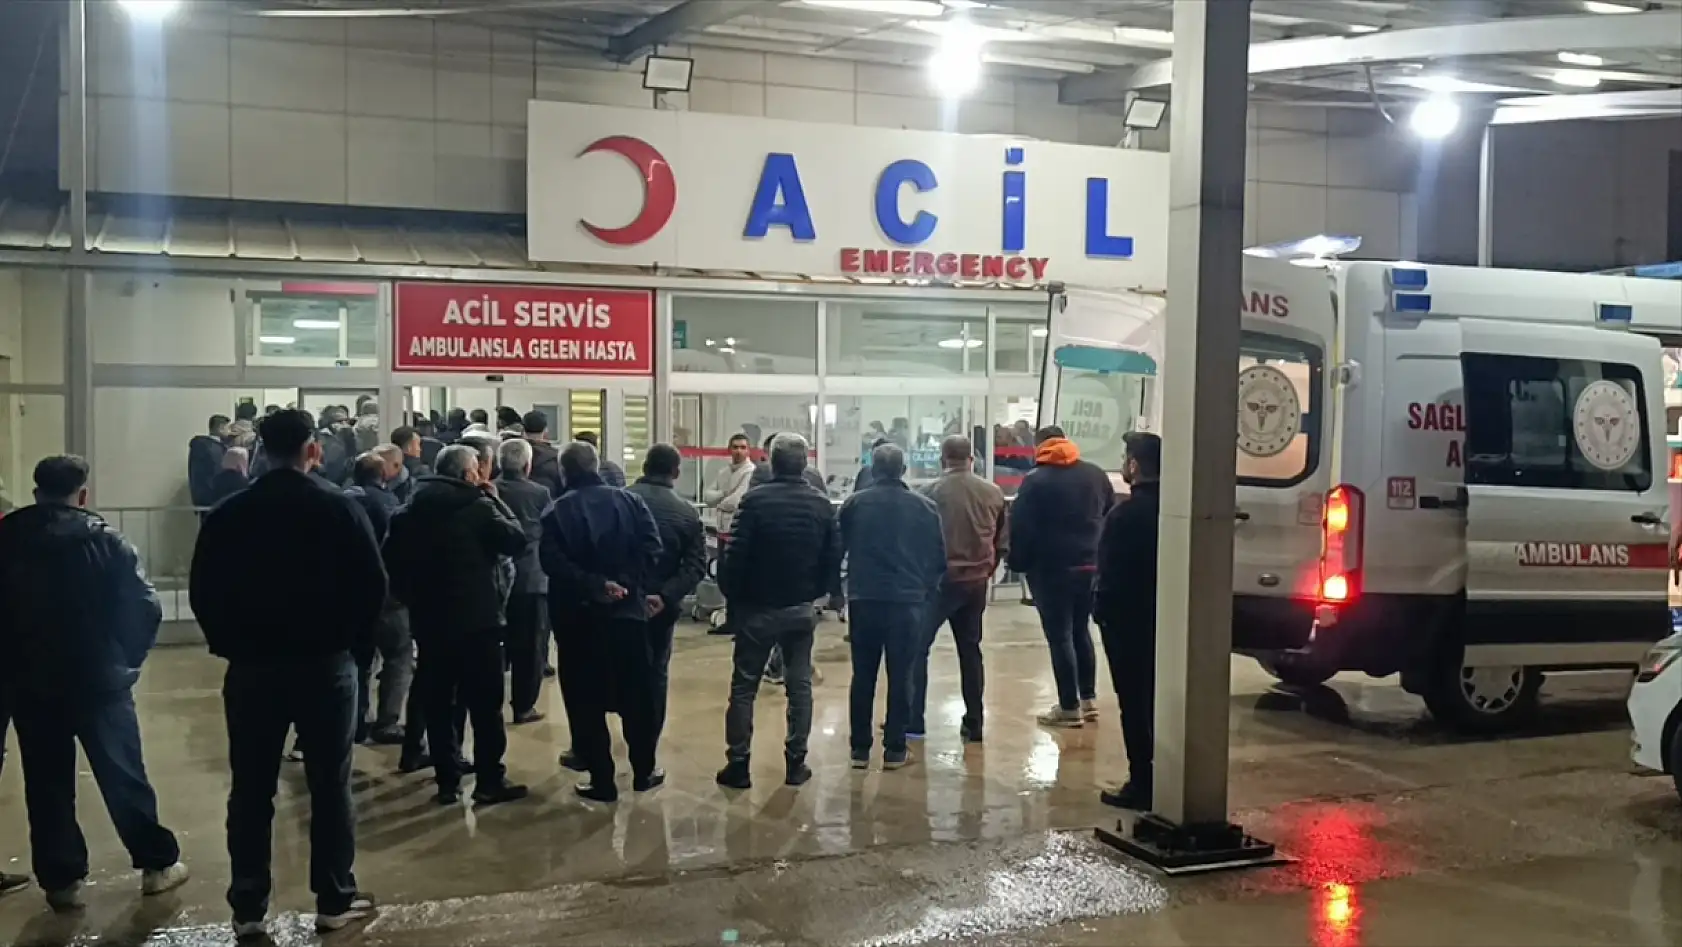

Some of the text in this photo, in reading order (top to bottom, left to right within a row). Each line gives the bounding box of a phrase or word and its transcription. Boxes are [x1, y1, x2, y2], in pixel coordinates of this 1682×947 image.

[743, 146, 1134, 257] ACİL
[840, 247, 1050, 280] EMERGENCY
[442, 294, 612, 329] ACİL SERVİS
[409, 335, 636, 361] AMBULANSLA GELEN HASTA
[1391, 480, 1412, 497] 112
[1516, 542, 1630, 567] AMBULANS
